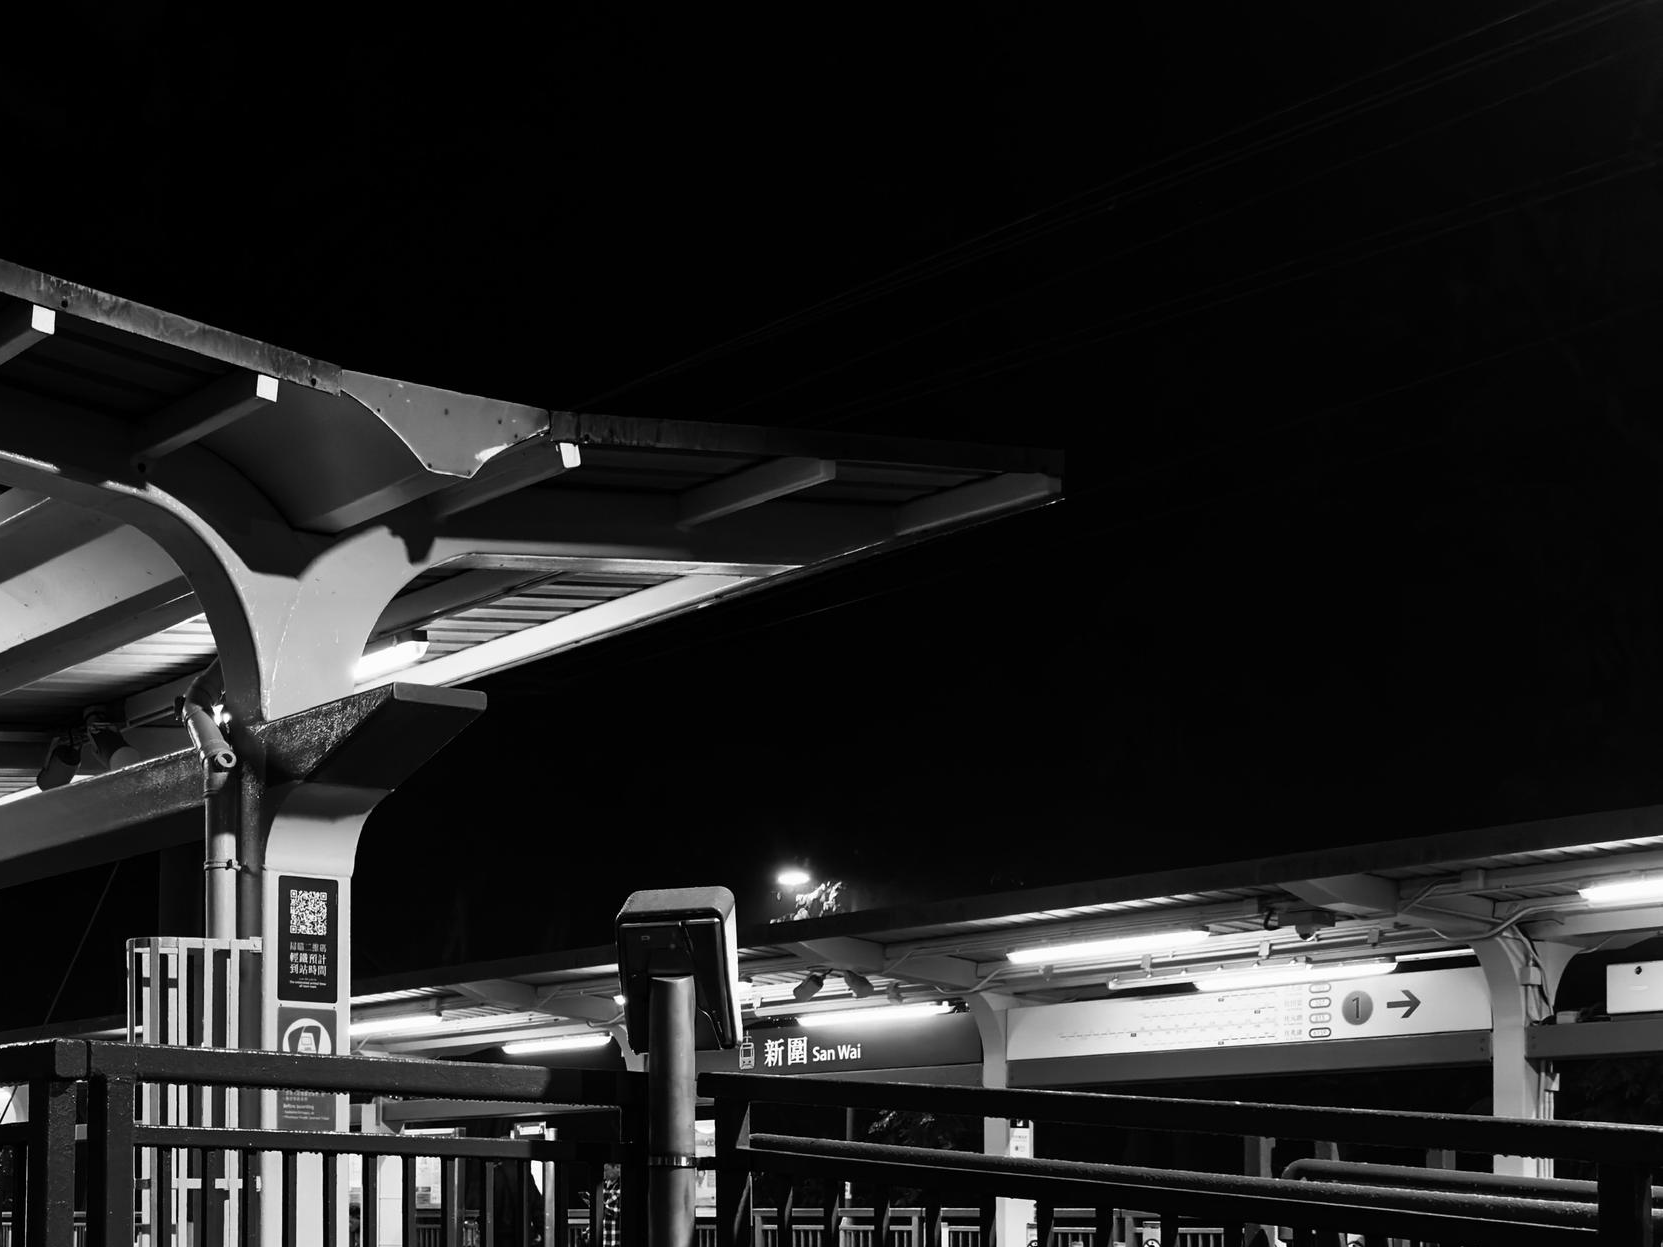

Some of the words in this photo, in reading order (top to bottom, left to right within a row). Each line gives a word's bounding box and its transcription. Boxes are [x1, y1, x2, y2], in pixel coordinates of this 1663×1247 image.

[764, 1036, 808, 1067] 新圍
[812, 1046, 836, 1062] San
[837, 1043, 861, 1060] Wai
